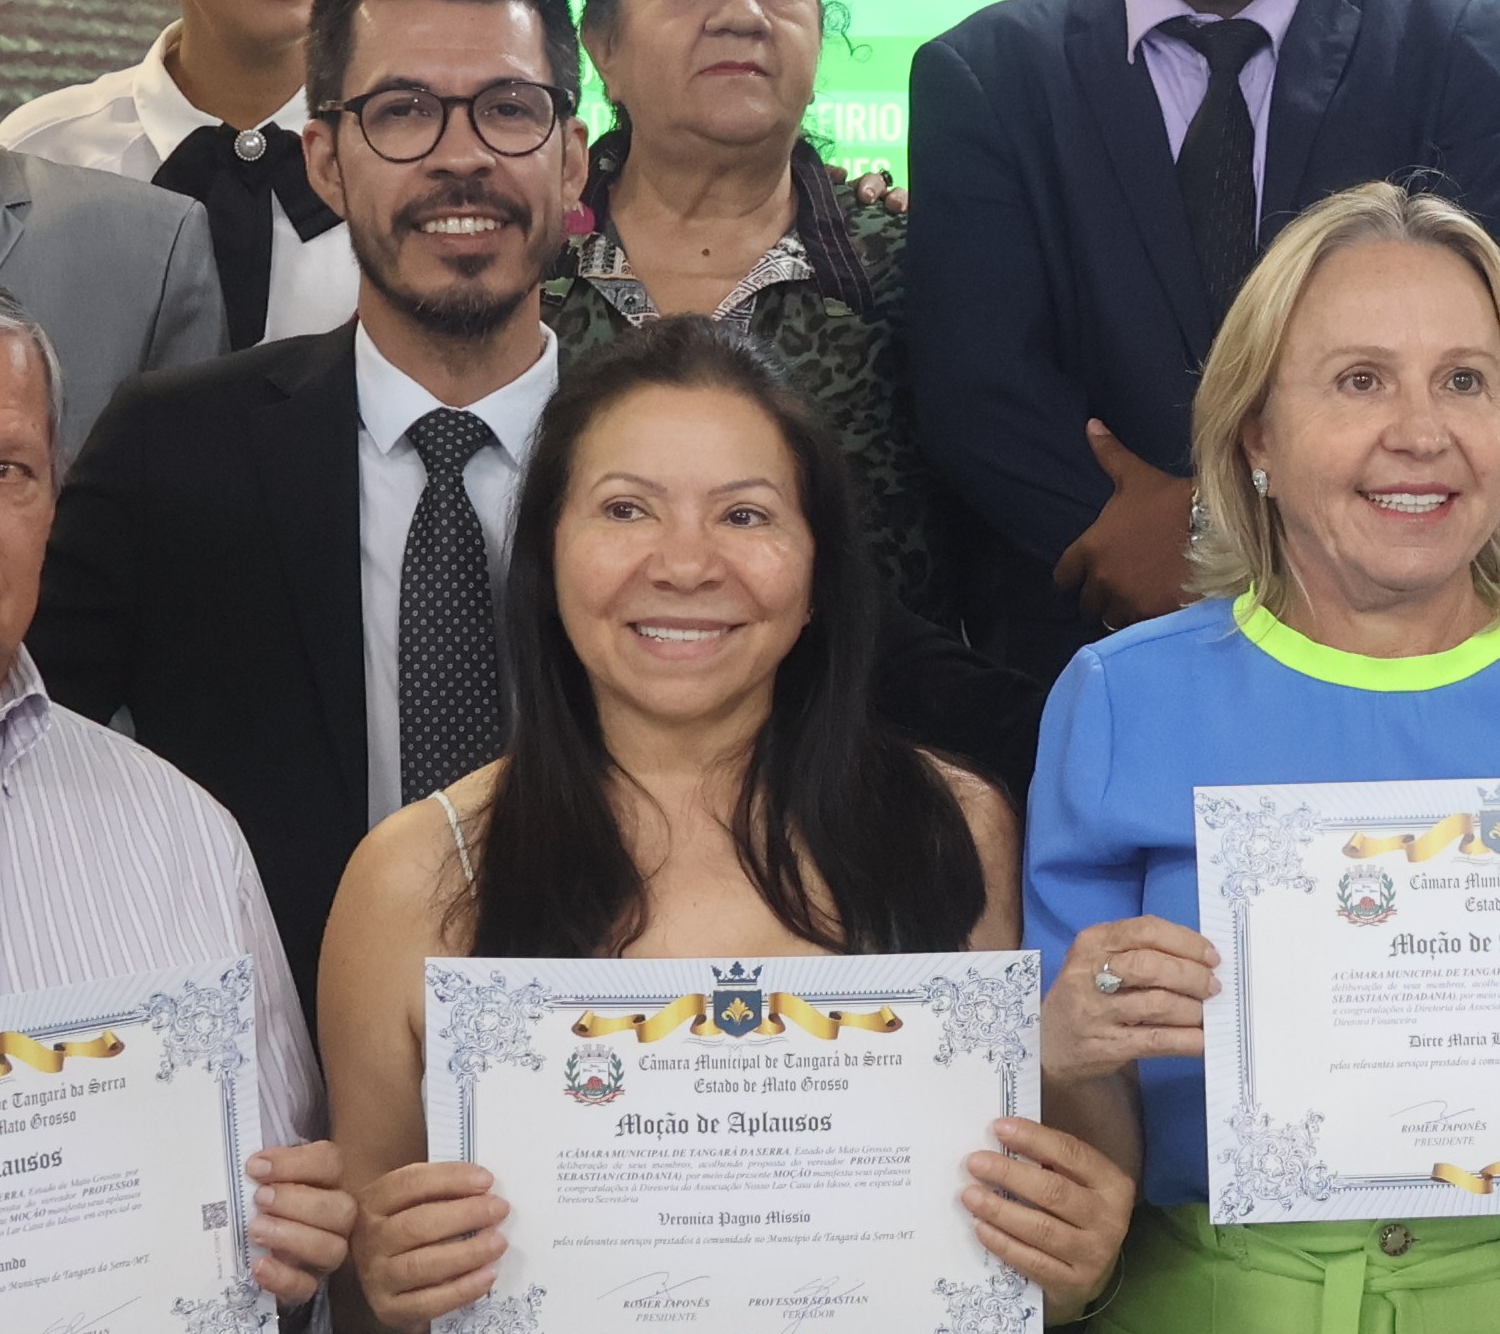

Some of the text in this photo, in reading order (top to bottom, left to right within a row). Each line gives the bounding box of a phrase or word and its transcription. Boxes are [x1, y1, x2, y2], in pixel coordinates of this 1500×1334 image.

[1410, 873, 1460, 890] Câmara
[1389, 931, 1461, 959] Moção
[1469, 933, 1491, 952] de
[1409, 1036, 1443, 1047] Dirce
[1448, 1034, 1486, 1047] Maria
[639, 1051, 902, 1071] Câmara Municipal de Tangará da Serra
[12, 1082, 66, 1108] Tangará
[70, 1084, 84, 1097] da
[88, 1078, 126, 1093] Serra
[615, 1112, 831, 1140] Moção de Aplausos
[1401, 1123, 1439, 1133] ROMER
[1414, 1137, 1475, 1148] PRESIDENTE
[659, 1213, 713, 1225] Veronica
[765, 1211, 810, 1224] Missio
